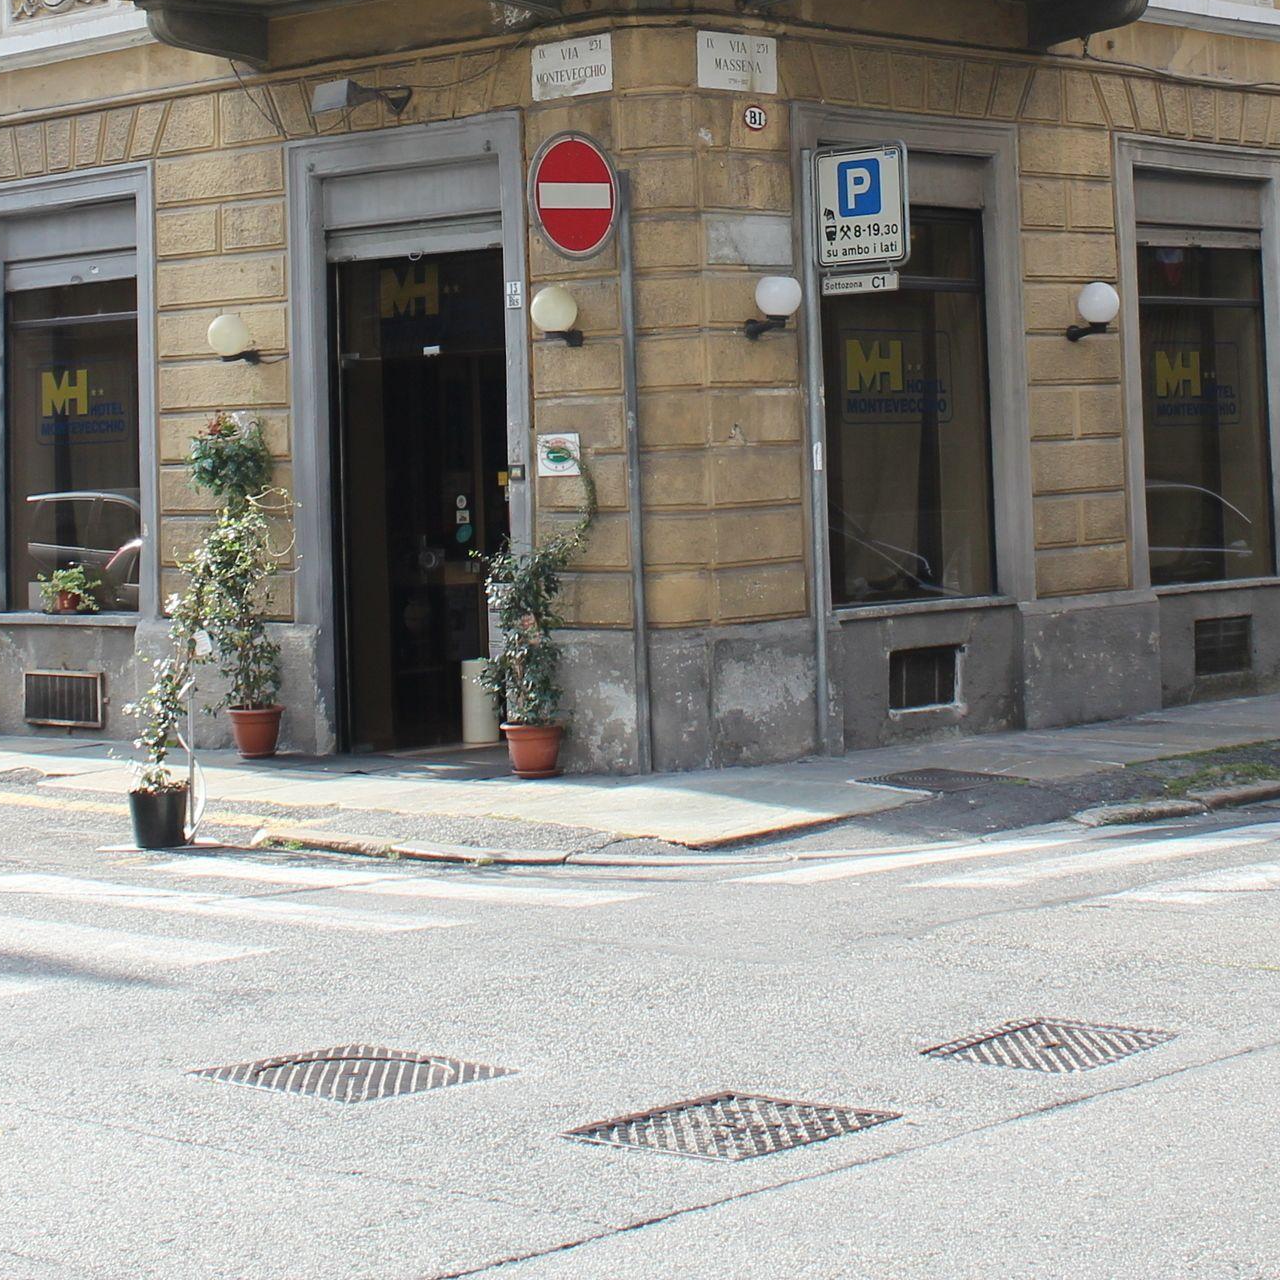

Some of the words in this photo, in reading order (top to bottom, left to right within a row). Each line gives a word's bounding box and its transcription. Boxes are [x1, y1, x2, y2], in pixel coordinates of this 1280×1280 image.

[561, 47, 579, 60] VIA
[729, 40, 747, 54] VIA
[714, 57, 762, 74] MASSENA
[536, 63, 607, 85] MONTEVECCHIO
[846, 167, 871, 210] P
[826, 247, 839, 258] su
[841, 244, 870, 257] ambo
[880, 240, 898, 253] lati
[825, 280, 863, 291] Sottozona
[871, 275, 887, 289] C1
[906, 379, 946, 393] HOL
[1204, 384, 1235, 399] TEL
[847, 398, 948, 414] MONTEVECCO
[1157, 401, 1236, 416] MONTEVHIO
[41, 419, 124, 436] MOEVECCHIO
